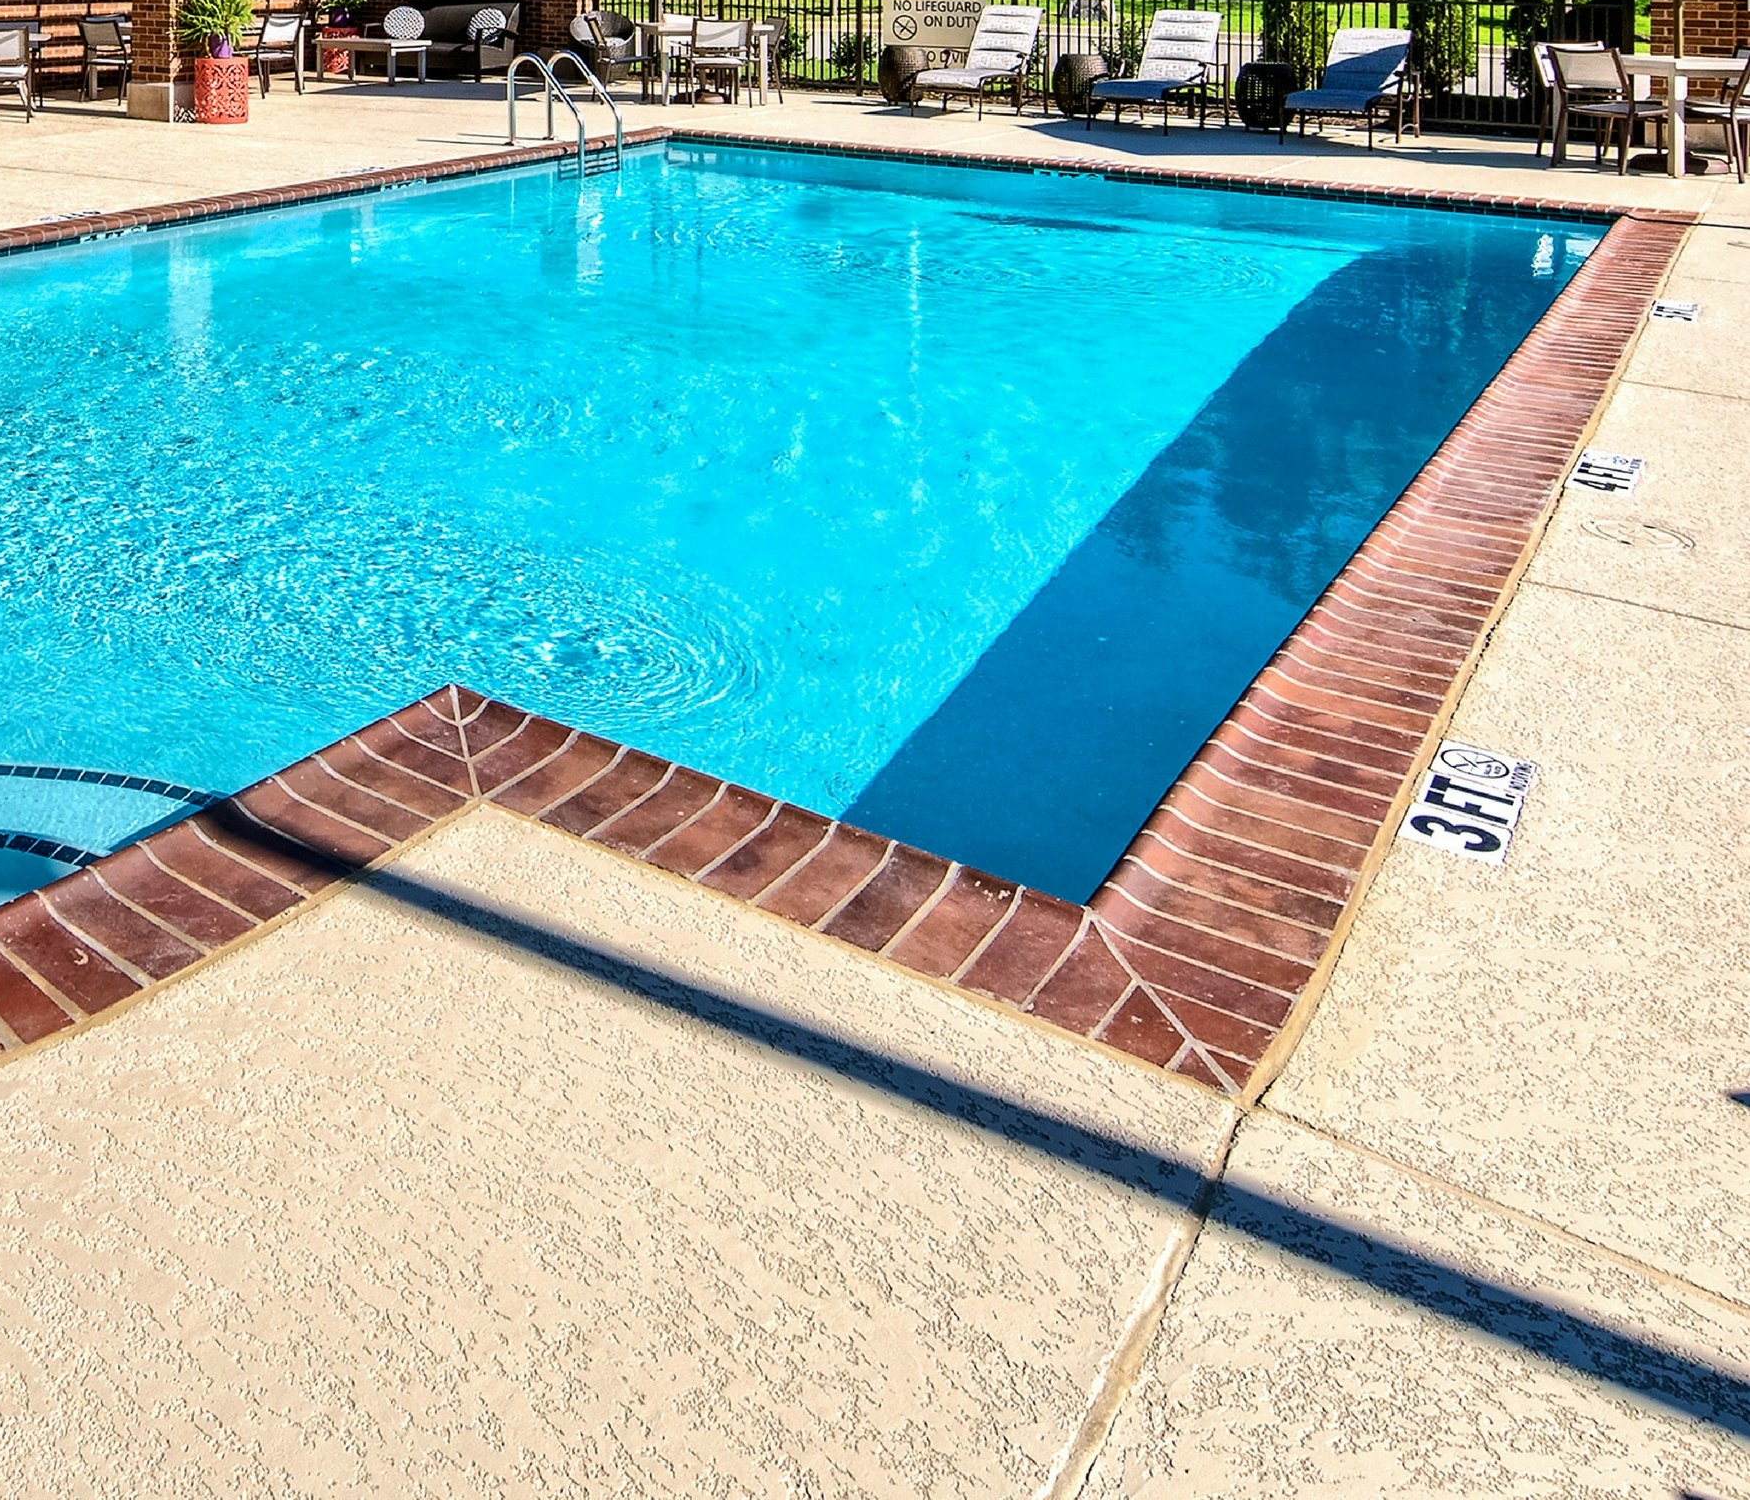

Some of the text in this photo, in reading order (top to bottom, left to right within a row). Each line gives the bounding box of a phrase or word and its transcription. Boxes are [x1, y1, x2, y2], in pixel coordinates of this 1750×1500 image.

[893, 0, 982, 13] NO LIFEGUARD
[924, 15, 979, 28] ON DUTY
